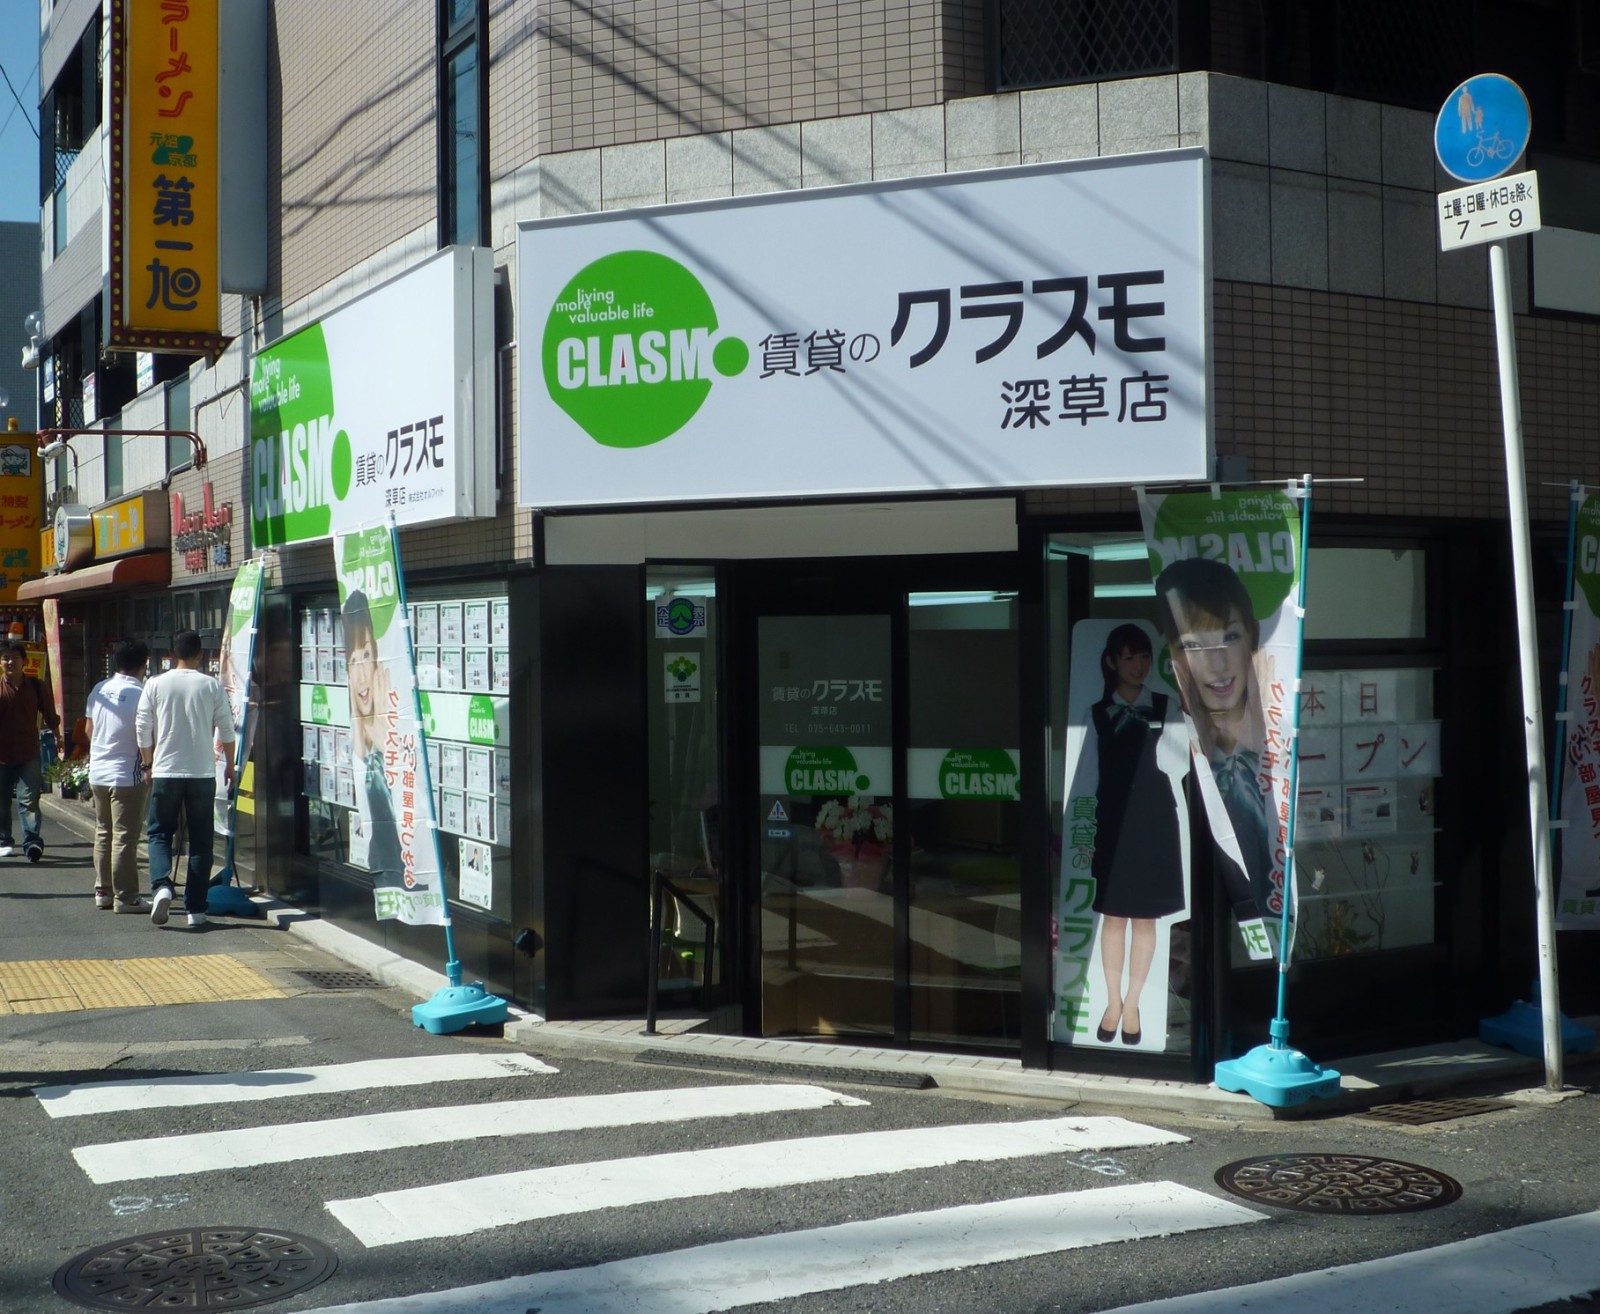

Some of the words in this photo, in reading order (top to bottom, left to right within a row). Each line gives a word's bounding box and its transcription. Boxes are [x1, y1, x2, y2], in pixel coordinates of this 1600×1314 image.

[146, 174, 201, 311] 第一旭
[555, 297, 592, 313] more
[577, 287, 615, 306] living
[568, 302, 630, 324] valuable
[632, 303, 654, 318] life
[1000, 370, 1170, 431] 深草店
[785, 723, 799, 733] TEL
